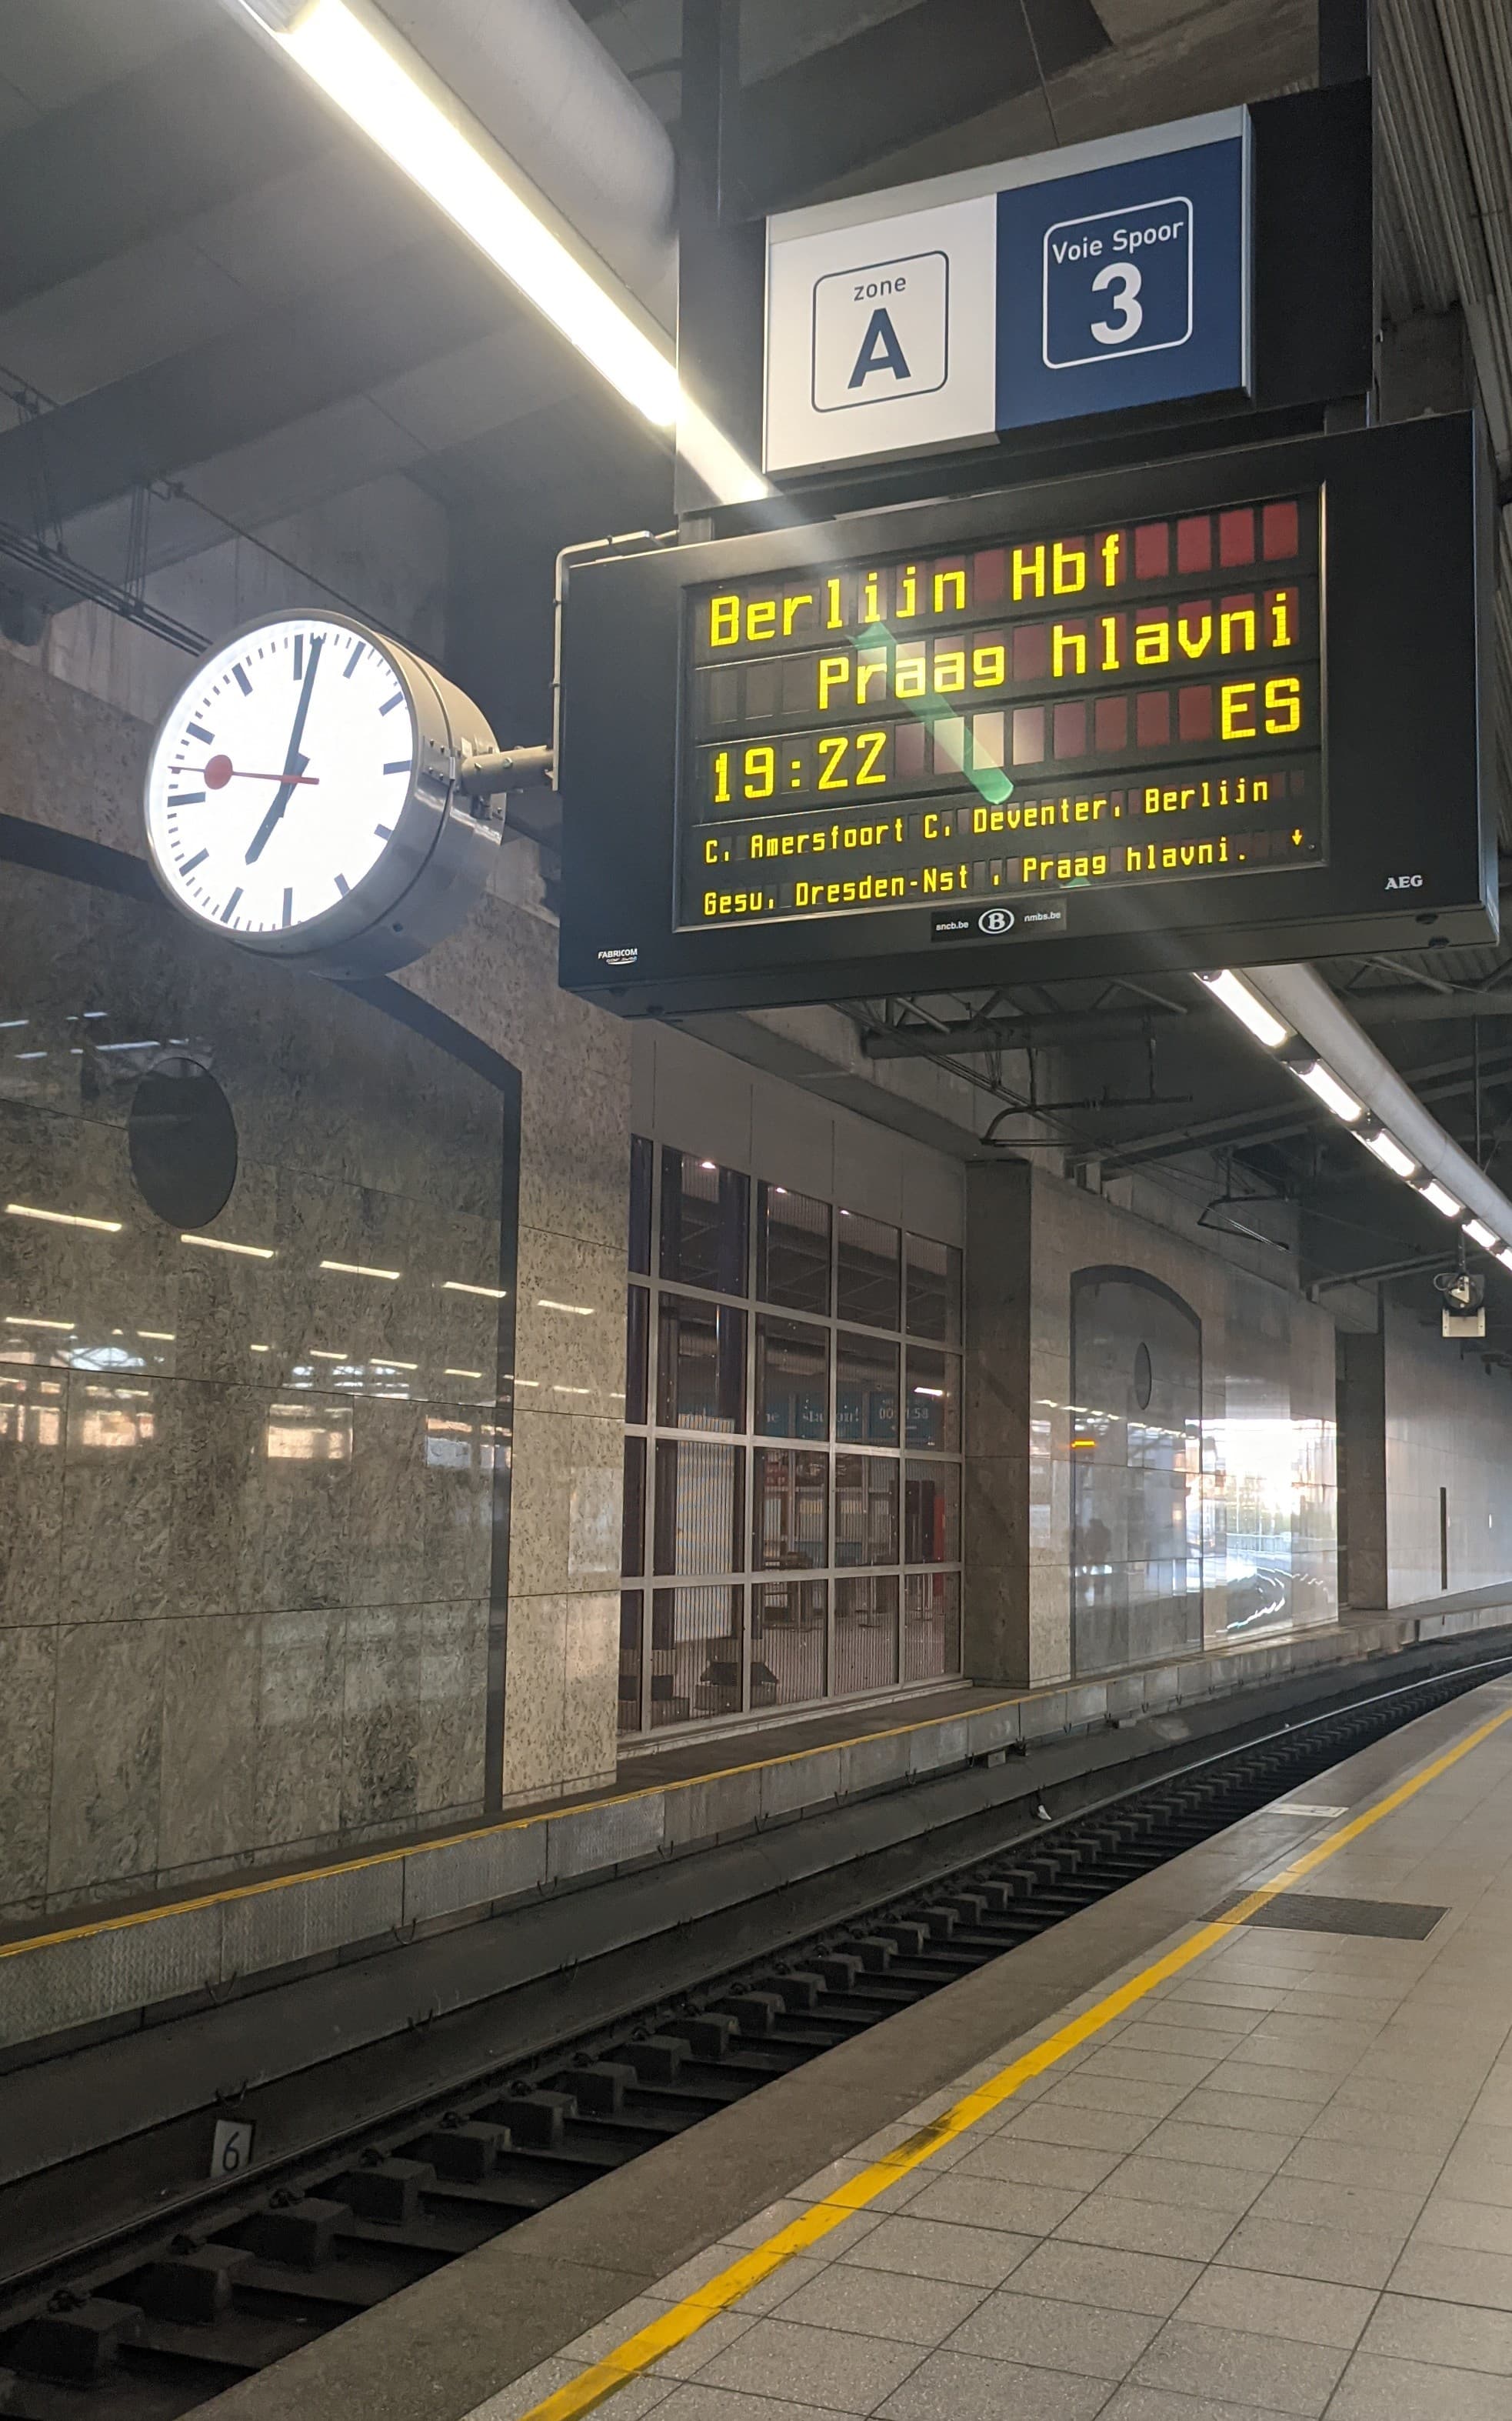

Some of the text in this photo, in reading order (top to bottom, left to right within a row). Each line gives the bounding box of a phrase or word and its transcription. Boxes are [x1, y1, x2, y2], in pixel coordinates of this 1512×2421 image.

[1053, 221, 1184, 264] Voie Spoor
[854, 275, 908, 302] zone
[1090, 262, 1144, 345] 3
[847, 307, 912, 389] A
[709, 532, 1121, 648] Berlijn Hbf
[817, 592, 1292, 711] Praag hlavni
[714, 676, 1302, 804] 19:22 ES
[750, 817, 904, 859] Amersfoort
[972, 798, 1121, 834] Deventer,
[1144, 777, 1269, 815] Berlijn
[704, 891, 775, 916] Gesu,
[795, 864, 968, 907] Dresden-Nst
[1022, 855, 1107, 883] Praag
[1126, 836, 1247, 872] hlavni.
[1384, 875, 1424, 890] AEG
[598, 947, 638, 960] FABRICOM
[935, 911, 1061, 932] sncb.be B nmbs.be
[222, 2131, 240, 2173] 6
